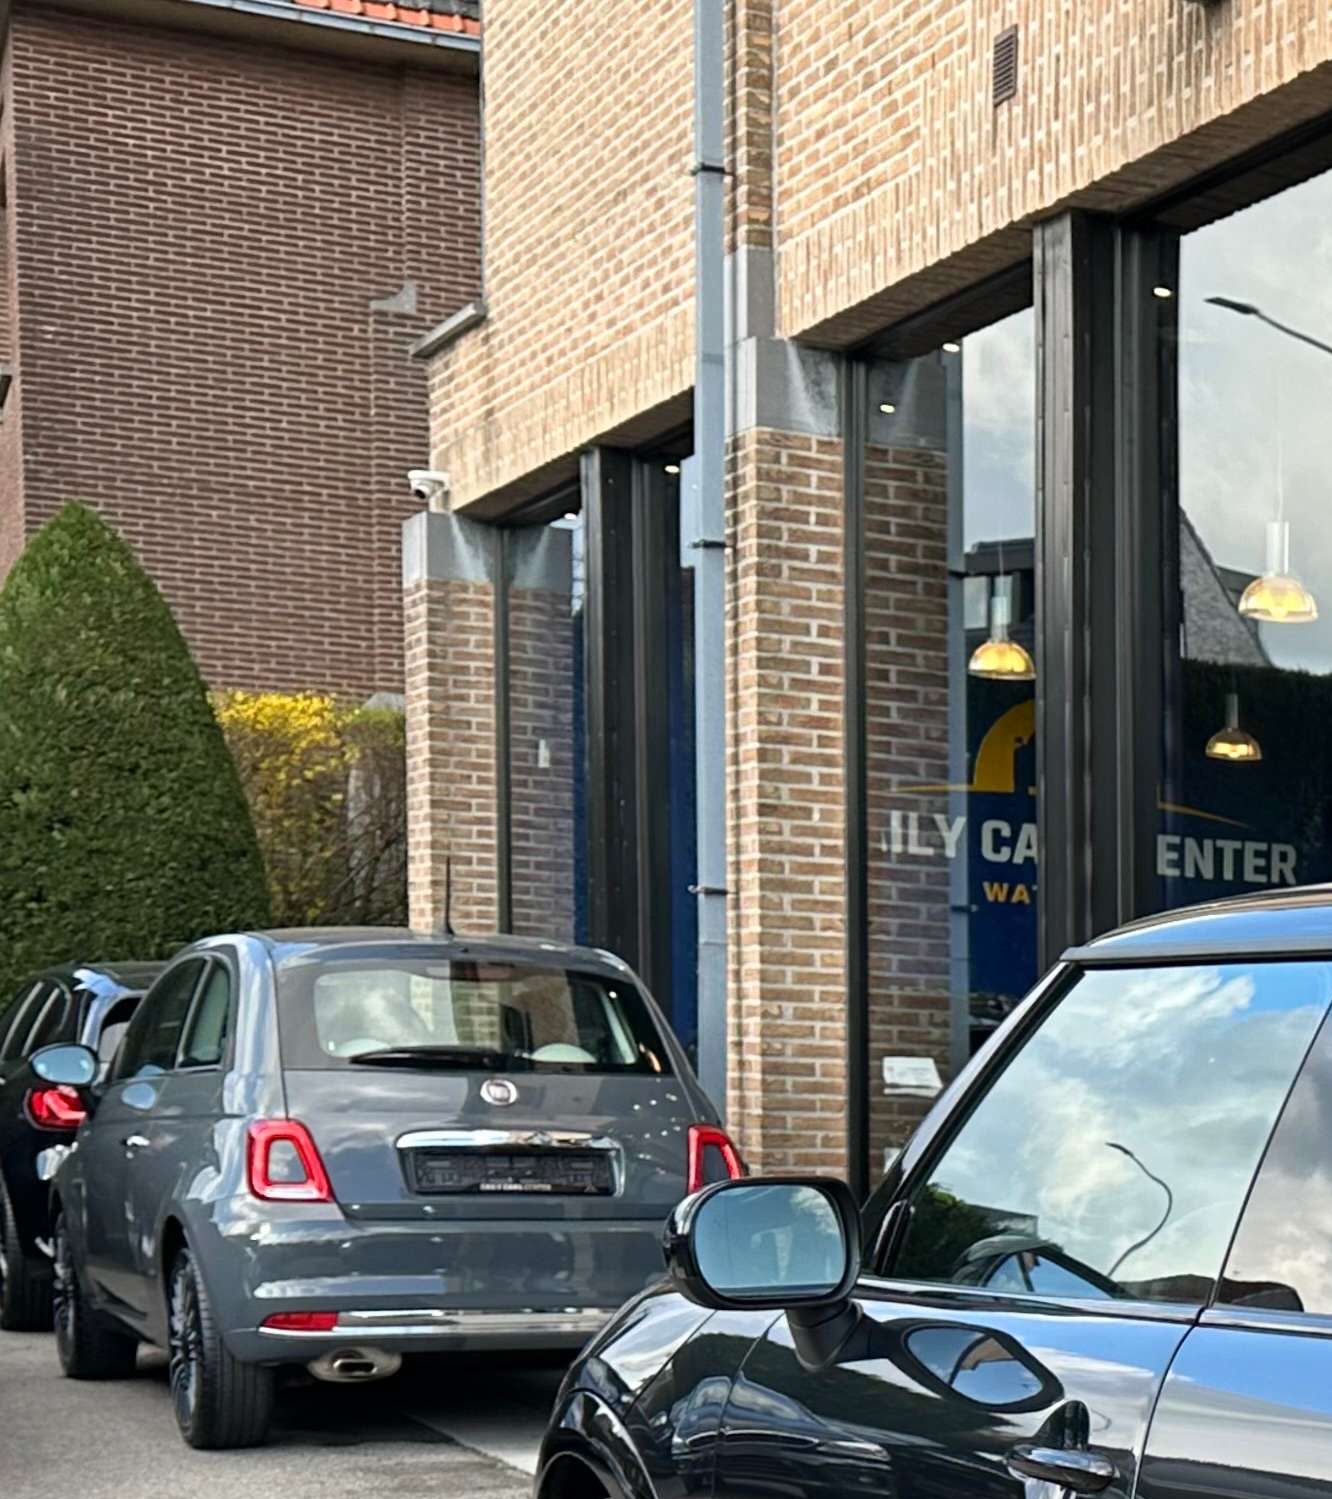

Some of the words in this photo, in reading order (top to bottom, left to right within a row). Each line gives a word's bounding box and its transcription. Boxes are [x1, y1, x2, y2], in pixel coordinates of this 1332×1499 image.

[880, 810, 967, 859] ILY
[1156, 834, 1297, 885] ENTER
[982, 881, 1038, 904] WA
